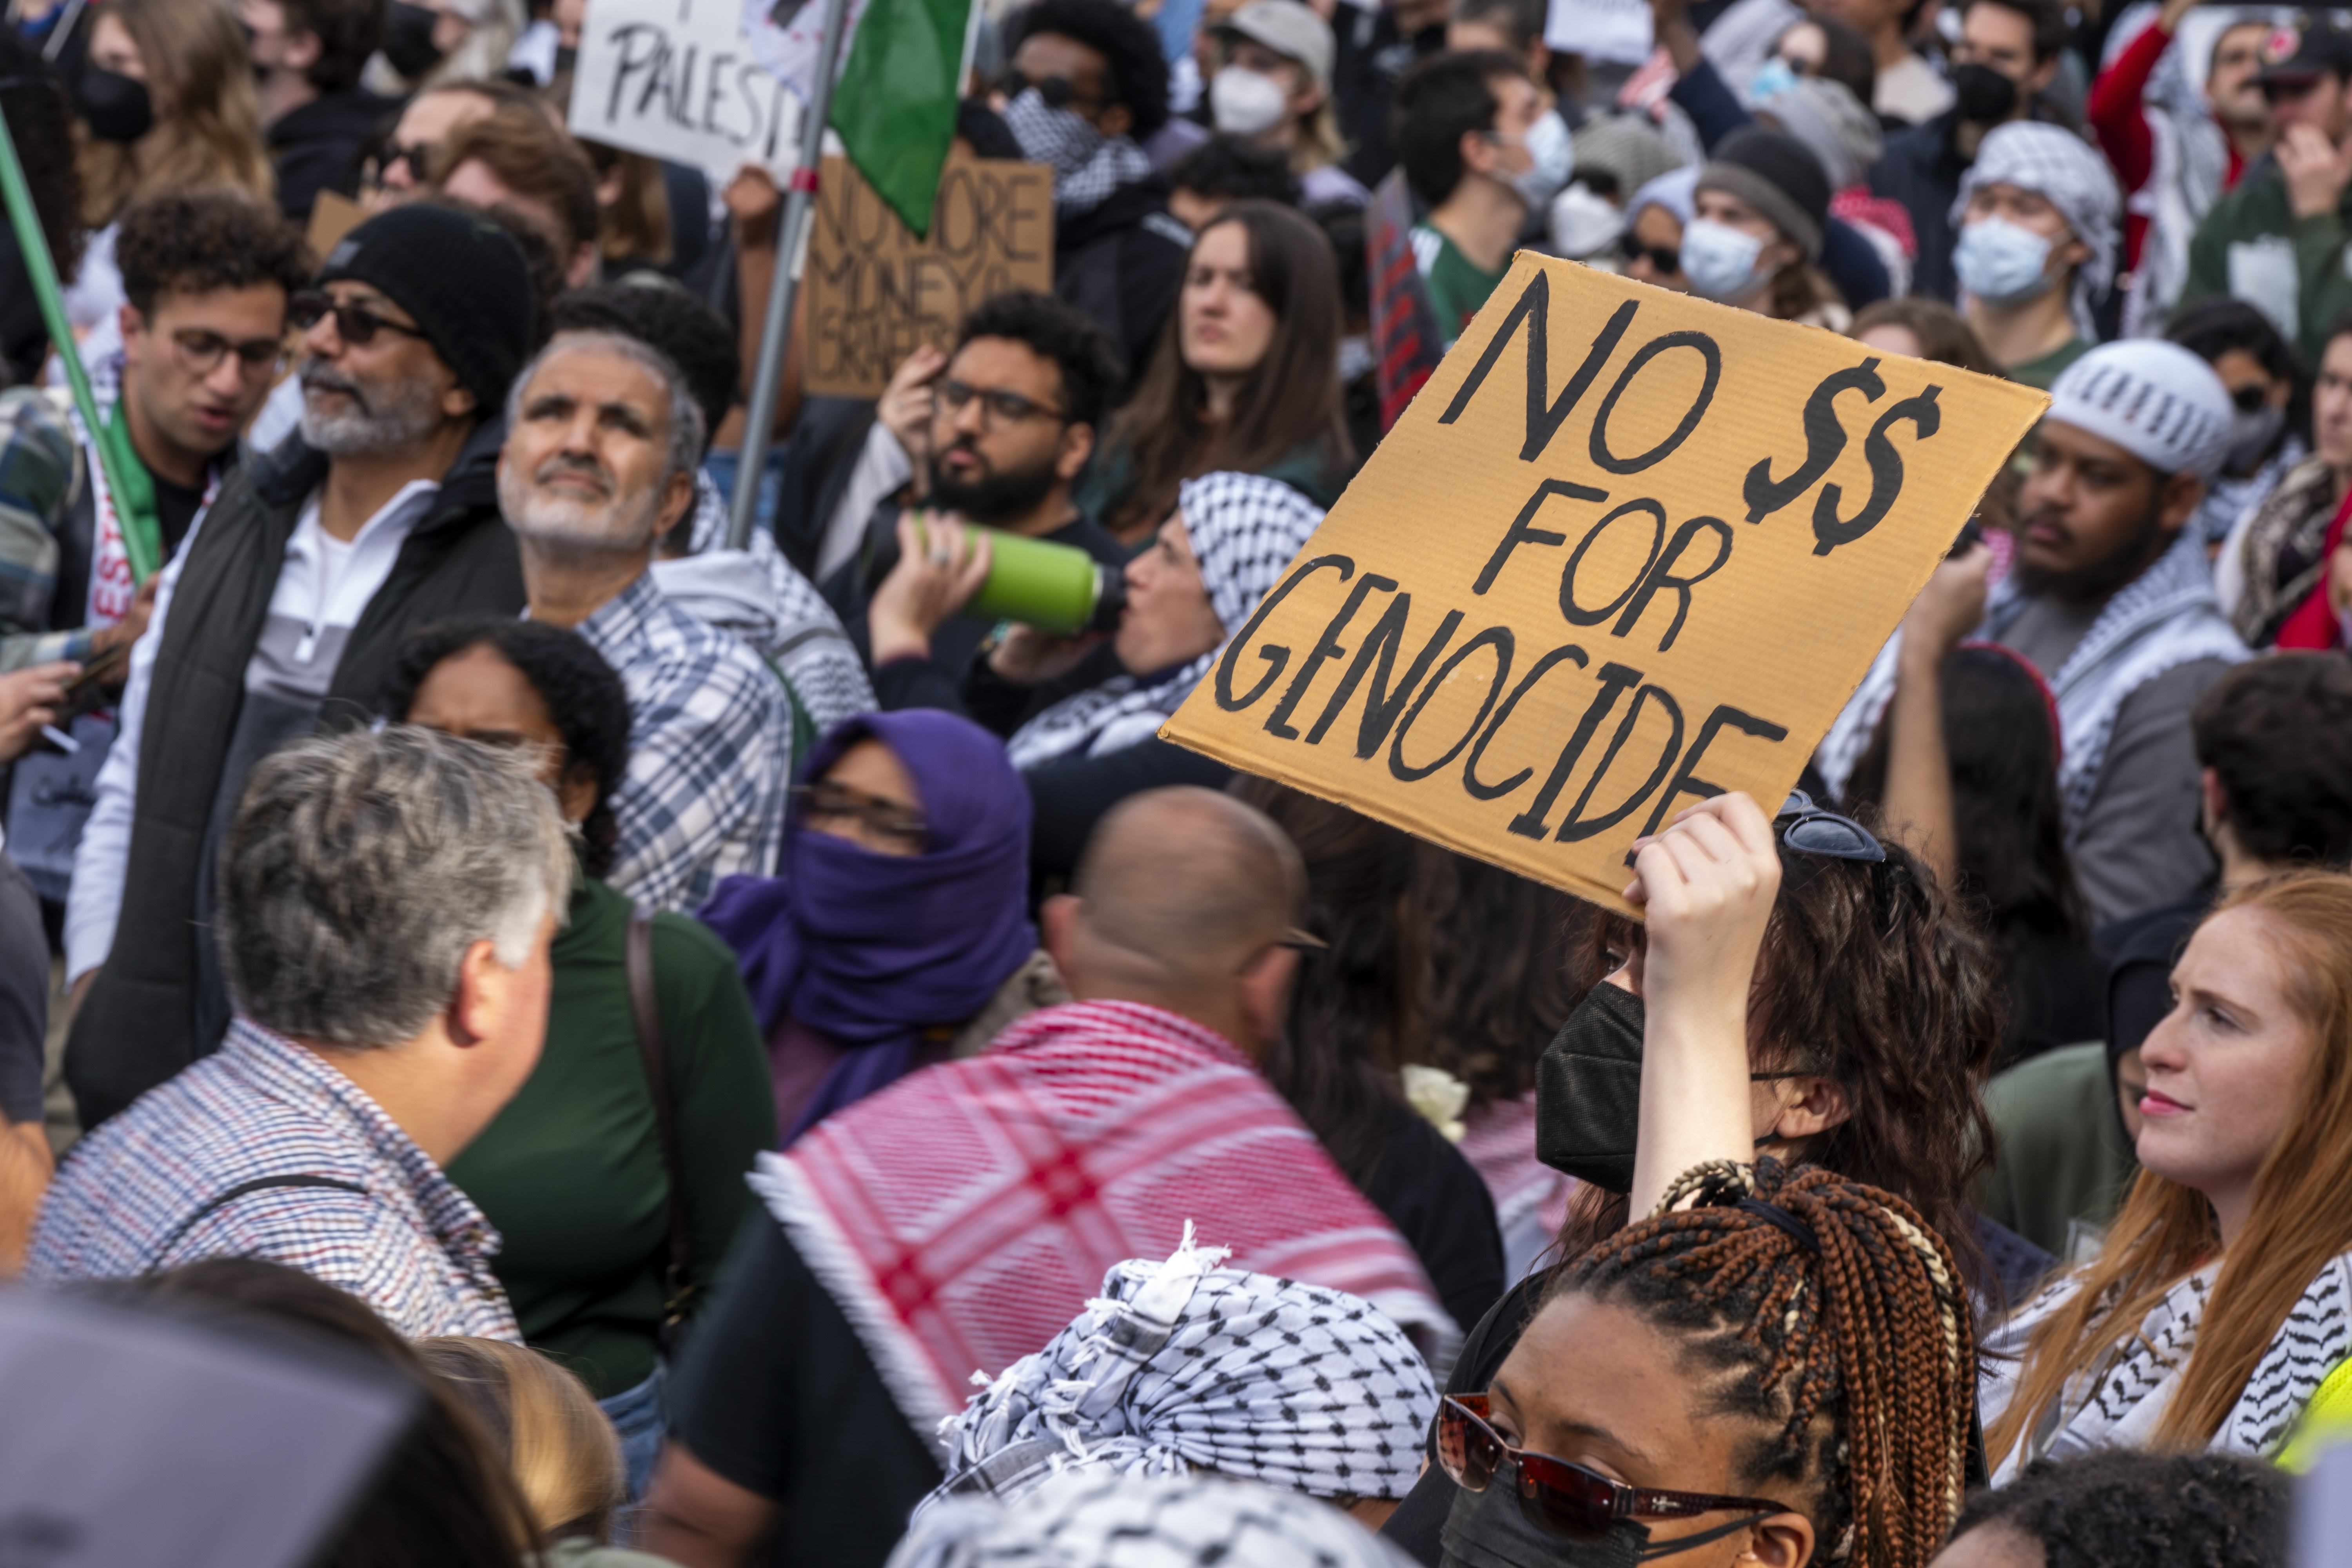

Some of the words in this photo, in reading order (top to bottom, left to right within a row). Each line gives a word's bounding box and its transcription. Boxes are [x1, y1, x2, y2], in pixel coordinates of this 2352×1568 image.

[1438, 268, 1721, 475] NO
[1743, 357, 1943, 557] $$
[1472, 477, 1733, 652] FOR
[1215, 554, 1788, 866] GENOCIDE
